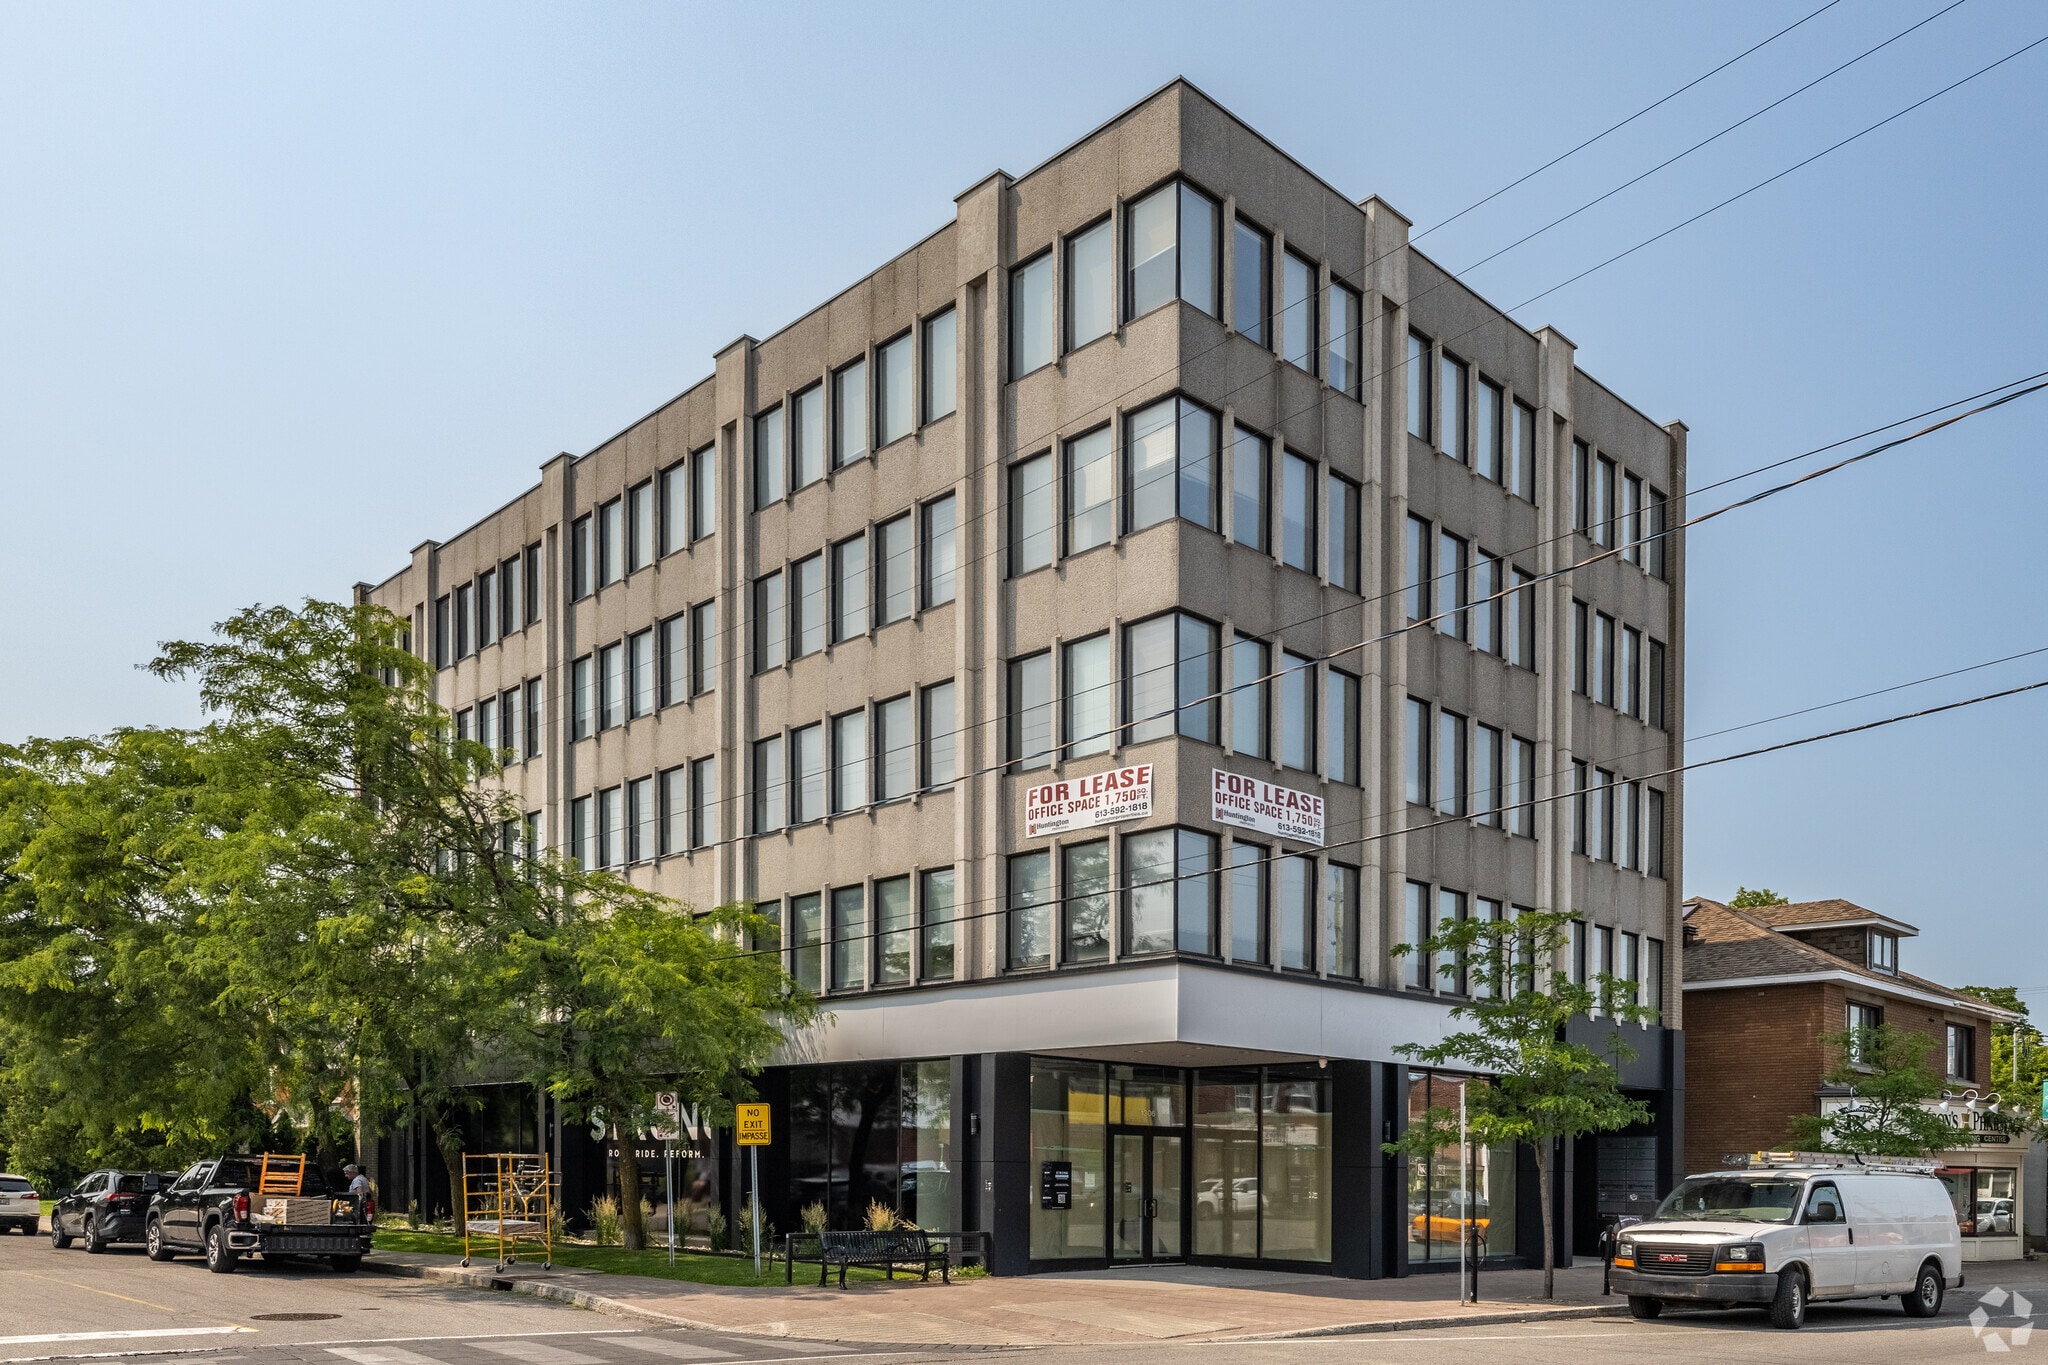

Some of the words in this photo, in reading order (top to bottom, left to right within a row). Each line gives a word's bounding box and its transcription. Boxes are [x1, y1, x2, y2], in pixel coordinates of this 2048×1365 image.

[1028, 783, 1069, 807] FOR
[1080, 766, 1150, 797] LEASE
[1215, 771, 1256, 798] FOR
[1264, 784, 1321, 816] LEASE
[1028, 803, 1063, 820] OFFICE
[1068, 796, 1100, 813] SPACE
[1105, 789, 1136, 806] 1,750
[1095, 802, 1148, 818] 613-592-1818
[1215, 791, 1250, 810] OFFICE
[1254, 801, 1282, 819] SPACE
[1286, 810, 1313, 826] 1,750
[1223, 809, 1256, 823] Huntington
[1036, 819, 1069, 829] Huntington
[1277, 822, 1321, 839] 613-592-1818
[747, 1108, 760, 1117] NO
[743, 1120, 763, 1129] EXIT
[740, 1131, 768, 1140] IMPASSE
[1983, 1135, 2007, 1143] CENTRE
[635, 1149, 659, 1158] RIDE.
[1658, 1253, 1688, 1262] GMC
